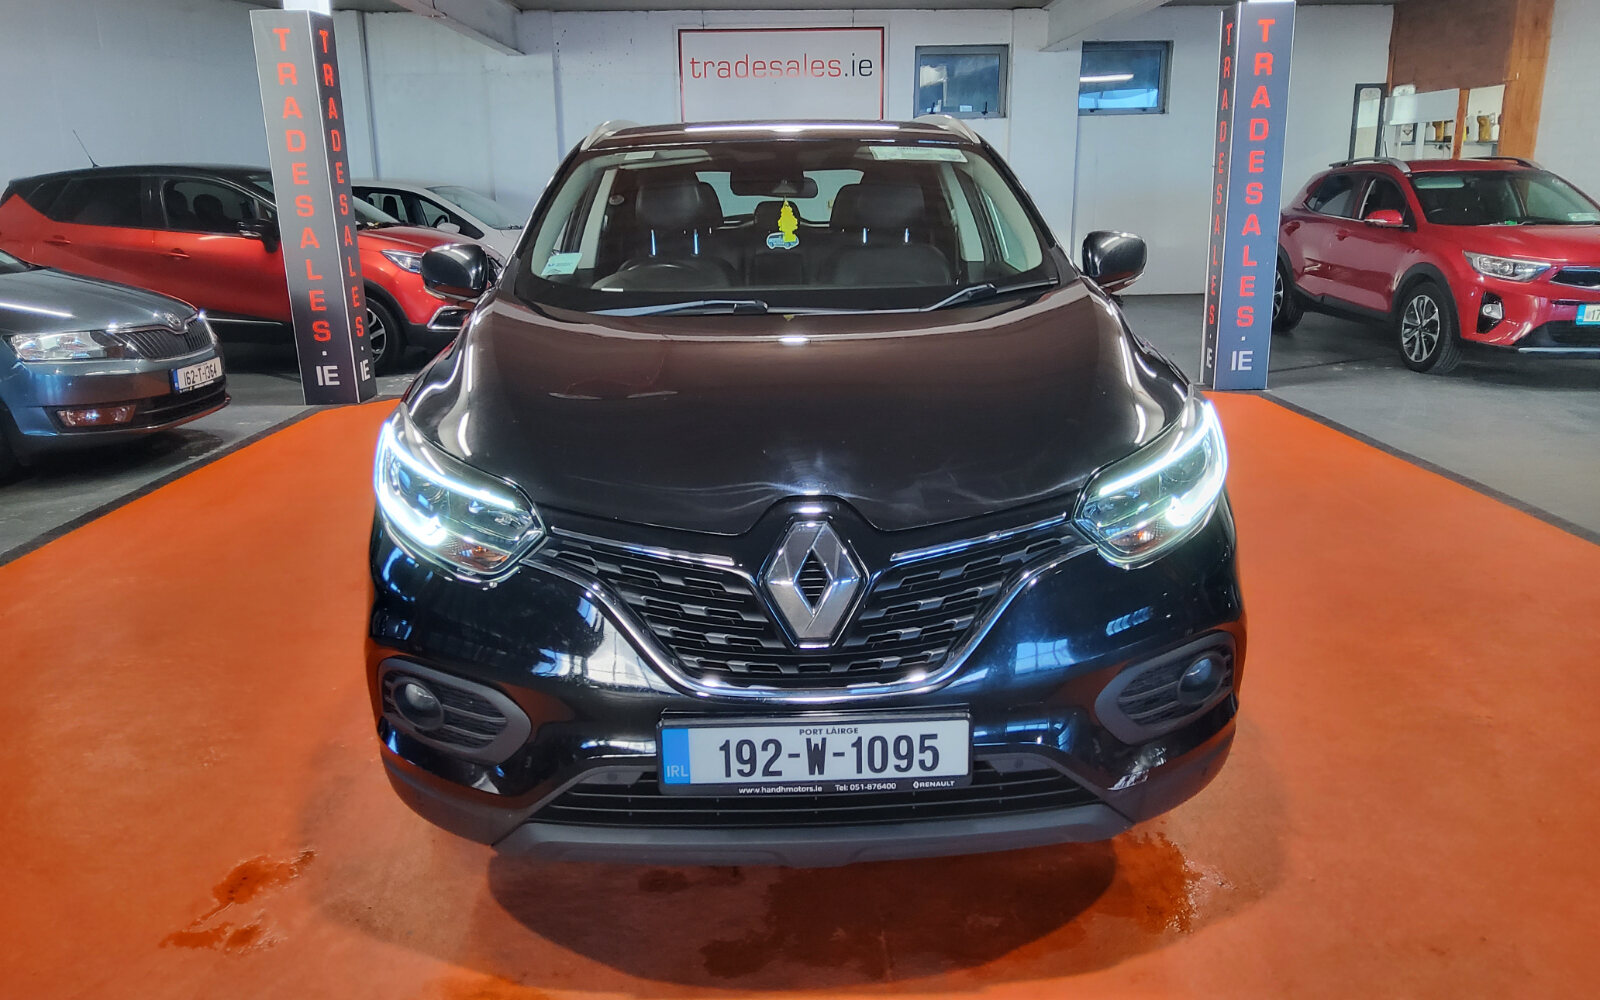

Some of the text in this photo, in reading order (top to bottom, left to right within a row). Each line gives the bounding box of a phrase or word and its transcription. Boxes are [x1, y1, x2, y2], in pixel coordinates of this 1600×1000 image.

[689, 52, 873, 79] tradesales.ie
[272, 28, 341, 386] TRADESALES.IE
[319, 30, 371, 382] TRADESALES.IE
[1231, 19, 1276, 371] TRADESALES.IE
[183, 362, 217, 386] 162-T-1364
[826, 726, 859, 735] LÁIRGE
[718, 733, 940, 778] 192-W-1095
[666, 764, 689, 777] IRL
[738, 780, 955, 794] www.handhmotors.ie Tel: 051-876400 RENAULT
